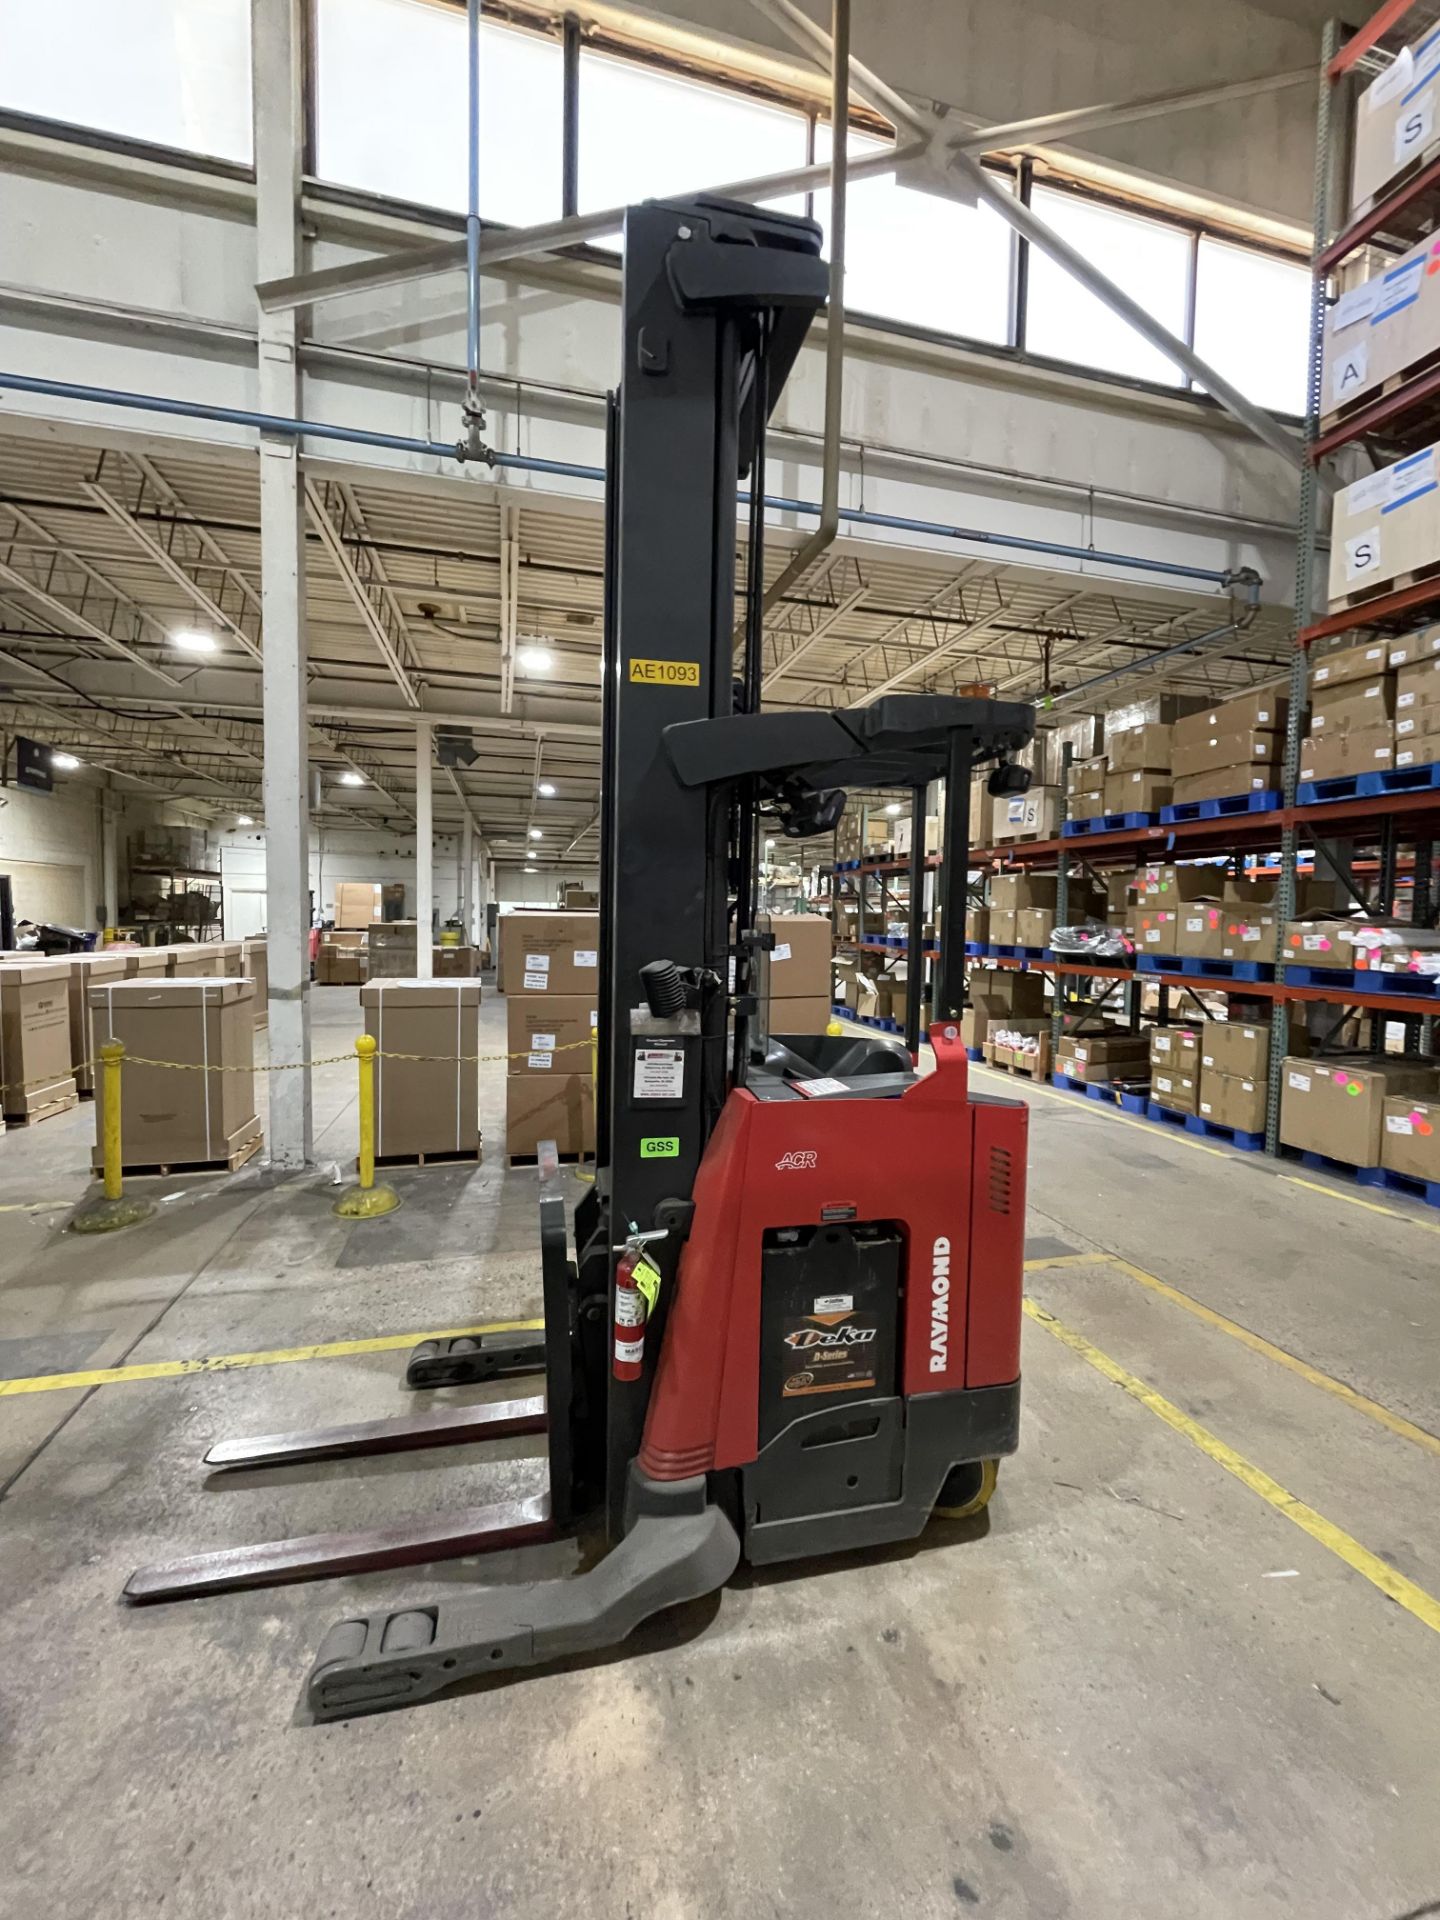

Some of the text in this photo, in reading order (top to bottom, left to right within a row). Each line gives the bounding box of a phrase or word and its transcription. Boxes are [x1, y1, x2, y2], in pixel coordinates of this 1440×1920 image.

[1404, 113, 1422, 144] S
[1340, 363, 1359, 390] A
[1354, 544, 1372, 569] S
[631, 662, 697, 682] AE1093
[1027, 807, 1036, 822] S
[646, 1140, 674, 1153] GSS
[775, 1150, 818, 1171] ACR
[929, 1236, 951, 1373] RAYMOND
[783, 1325, 877, 1350] Deka
